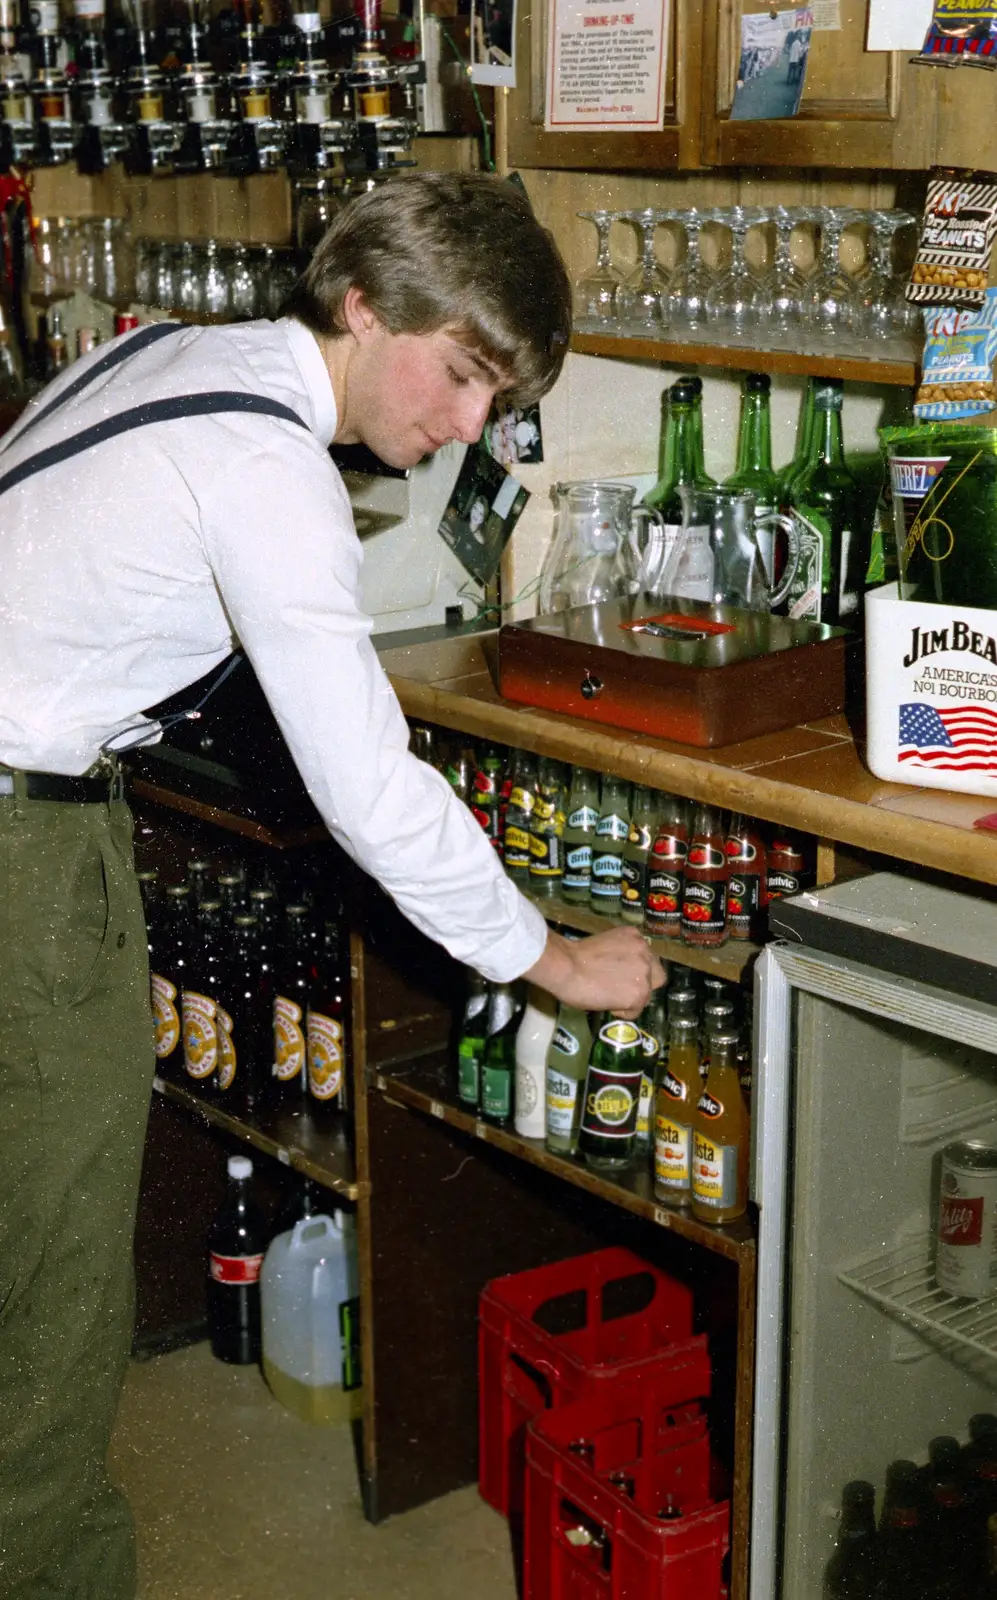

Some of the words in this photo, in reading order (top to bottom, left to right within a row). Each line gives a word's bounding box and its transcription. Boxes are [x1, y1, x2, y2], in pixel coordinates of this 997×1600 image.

[937, 192, 969, 215] KP
[946, 217, 987, 231] Roasted
[921, 227, 985, 248] PEANUTS
[904, 626, 950, 667] JIM
[922, 667, 997, 687] AMERICA'S
[939, 684, 997, 704] BOURBO
